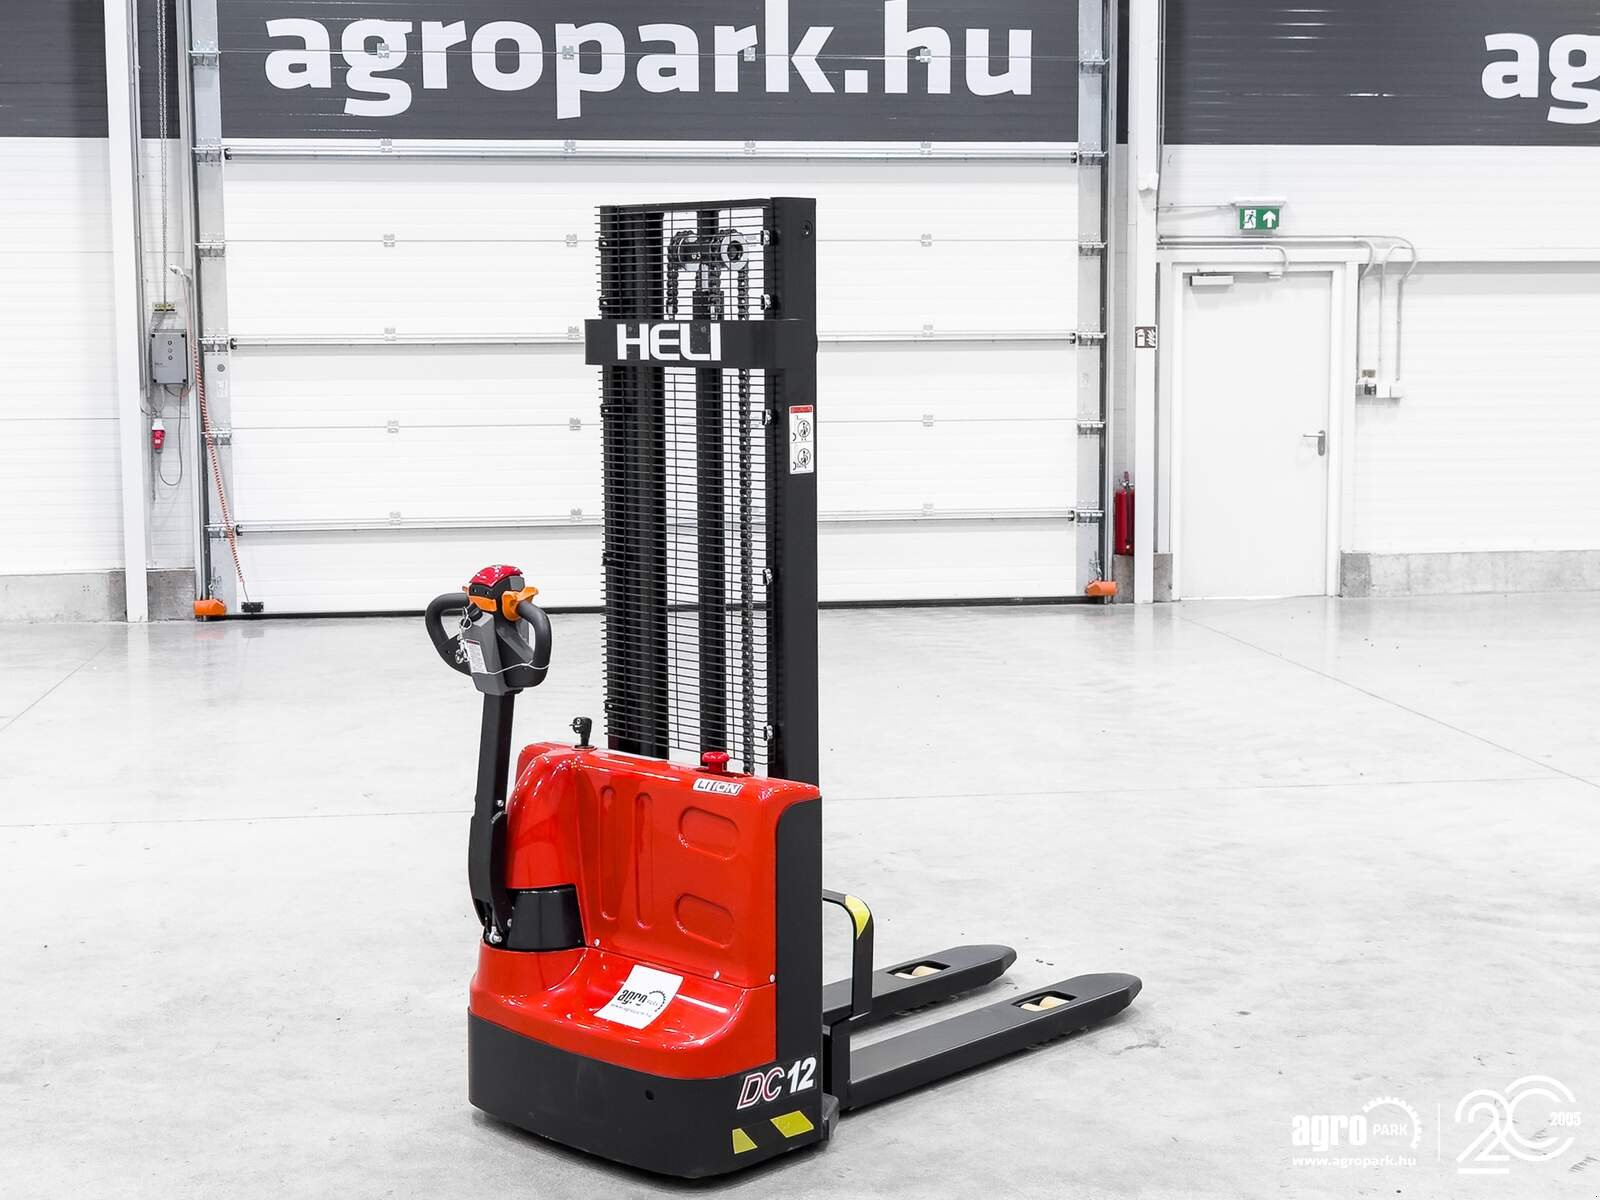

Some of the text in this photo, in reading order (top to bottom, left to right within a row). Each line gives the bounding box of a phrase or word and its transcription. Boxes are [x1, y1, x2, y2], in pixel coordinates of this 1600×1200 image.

[265, 0, 1033, 119] agropark.hu
[616, 322, 721, 361] HELI
[736, 1057, 817, 1110] DC 12
